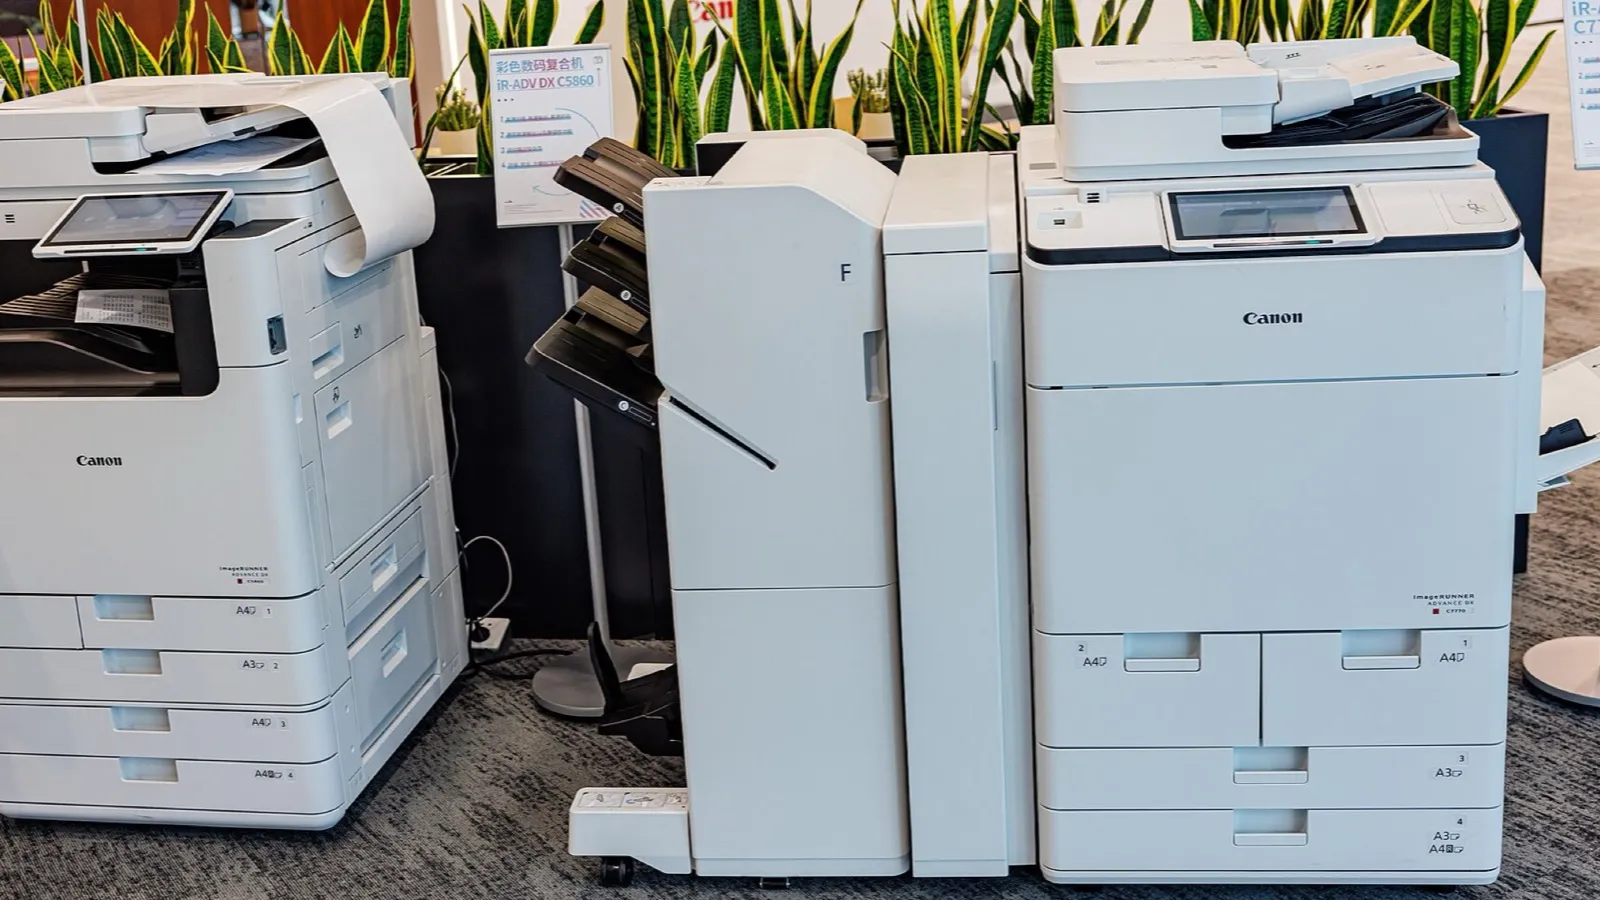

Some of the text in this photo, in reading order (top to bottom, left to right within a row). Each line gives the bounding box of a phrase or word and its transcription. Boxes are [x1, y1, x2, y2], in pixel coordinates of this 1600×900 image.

[1574, 20, 1600, 34] C7
[496, 57, 584, 73] 彩色数码复合机
[497, 75, 594, 91] iR-ADV DX C5860
[841, 263, 851, 281] F
[1243, 312, 1303, 325] Canon
[76, 455, 123, 466] Canon
[236, 606, 250, 614] A4
[1078, 644, 1084, 652] 2
[1083, 657, 1099, 666] A4
[1439, 652, 1456, 662] A4
[243, 659, 256, 669] A3
[252, 718, 265, 726] A4
[1435, 768, 1452, 777] A3
[1433, 831, 1450, 840] A3
